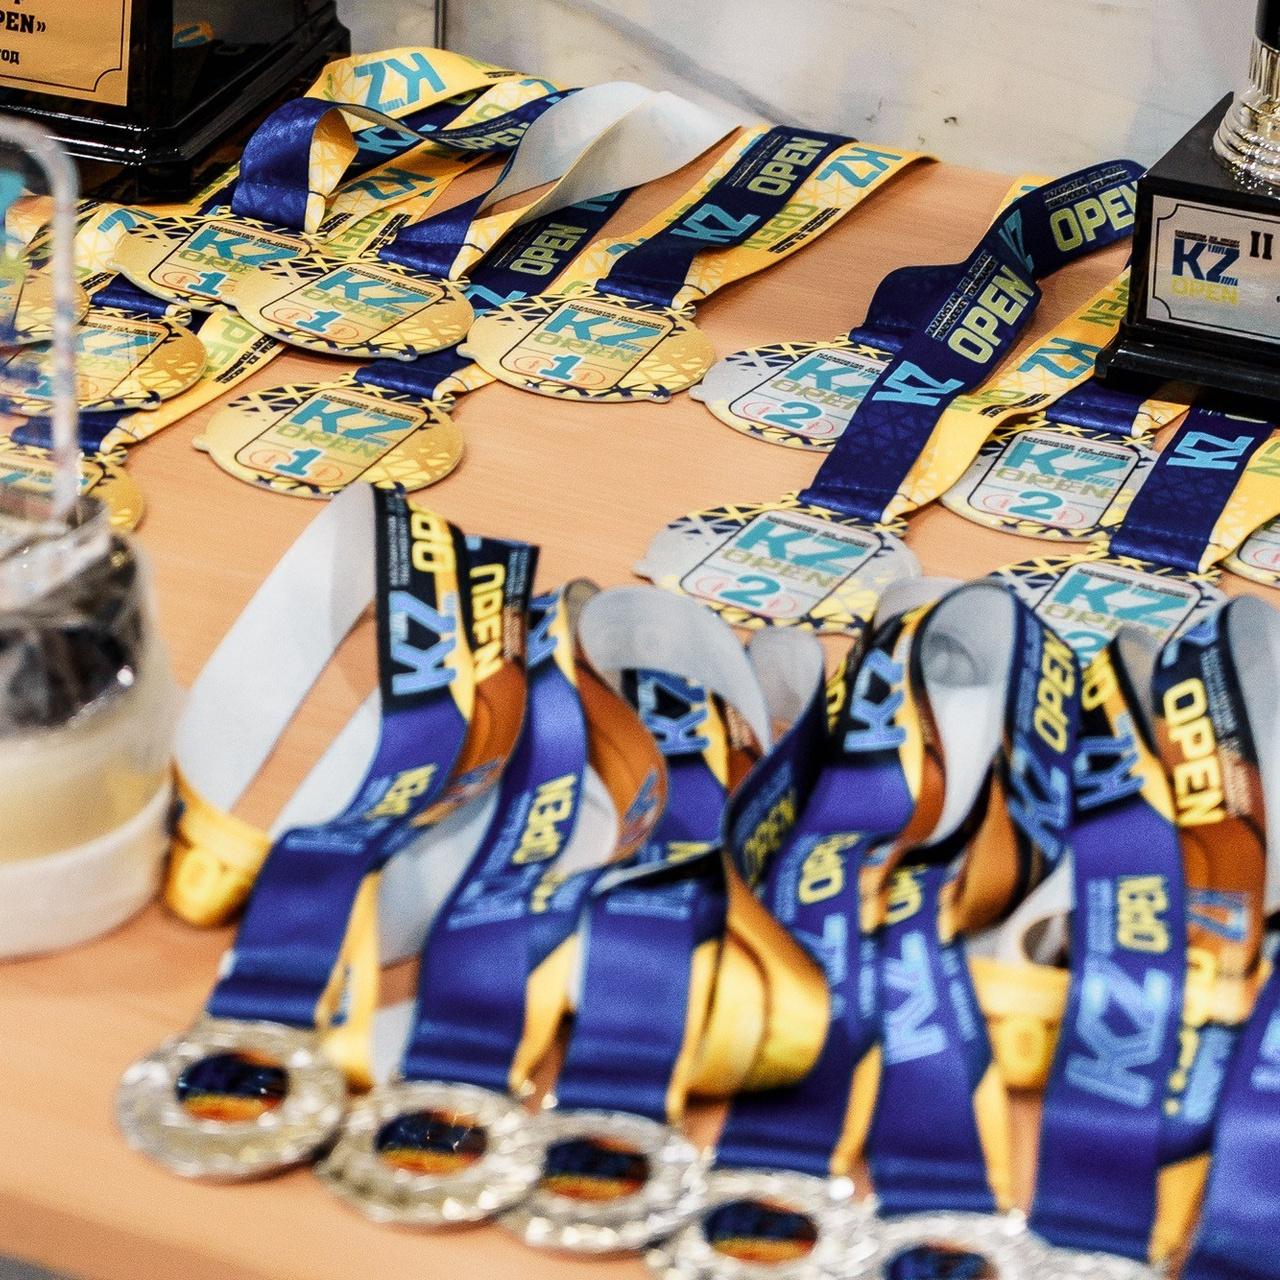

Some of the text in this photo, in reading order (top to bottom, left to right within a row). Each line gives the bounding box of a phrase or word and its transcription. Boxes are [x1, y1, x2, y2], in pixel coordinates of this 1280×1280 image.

[354, 52, 447, 115] KZ
[747, 137, 828, 197] OPEN
[670, 203, 761, 243] KZ
[178, 249, 255, 275] OPE
[187, 228, 300, 266] KZ
[509, 223, 588, 276] OPEN
[1172, 238, 1240, 287] KZ
[1249, 231, 1274, 260] II
[187, 271, 226, 296] 1
[315, 270, 431, 317] KZ
[1171, 276, 1238, 305] OPEN
[294, 308, 344, 333] 1
[300, 288, 398, 323] OPEN
[947, 264, 1035, 364] OPEN
[533, 331, 635, 363] OPEN
[543, 308, 664, 353] KZ
[538, 352, 583, 381] 1
[872, 360, 965, 406] KZ
[290, 398, 414, 448] KZ
[763, 401, 823, 429] 2
[276, 424, 383, 458] OPEN
[1166, 431, 1255, 471] KZ
[273, 447, 323, 476] 1
[1003, 442, 1129, 487] KZ
[994, 467, 1112, 499] OPEN
[1007, 491, 1063, 520] 2
[722, 548, 837, 588] OPEN
[734, 520, 868, 577] KZ
[719, 574, 781, 608] 2
[1052, 573, 1191, 629] KZ
[388, 590, 458, 696] KZ
[1033, 630, 1076, 755] OPEN
[1164, 677, 1227, 827] OPEN
[1064, 955, 1173, 1109] KZ
